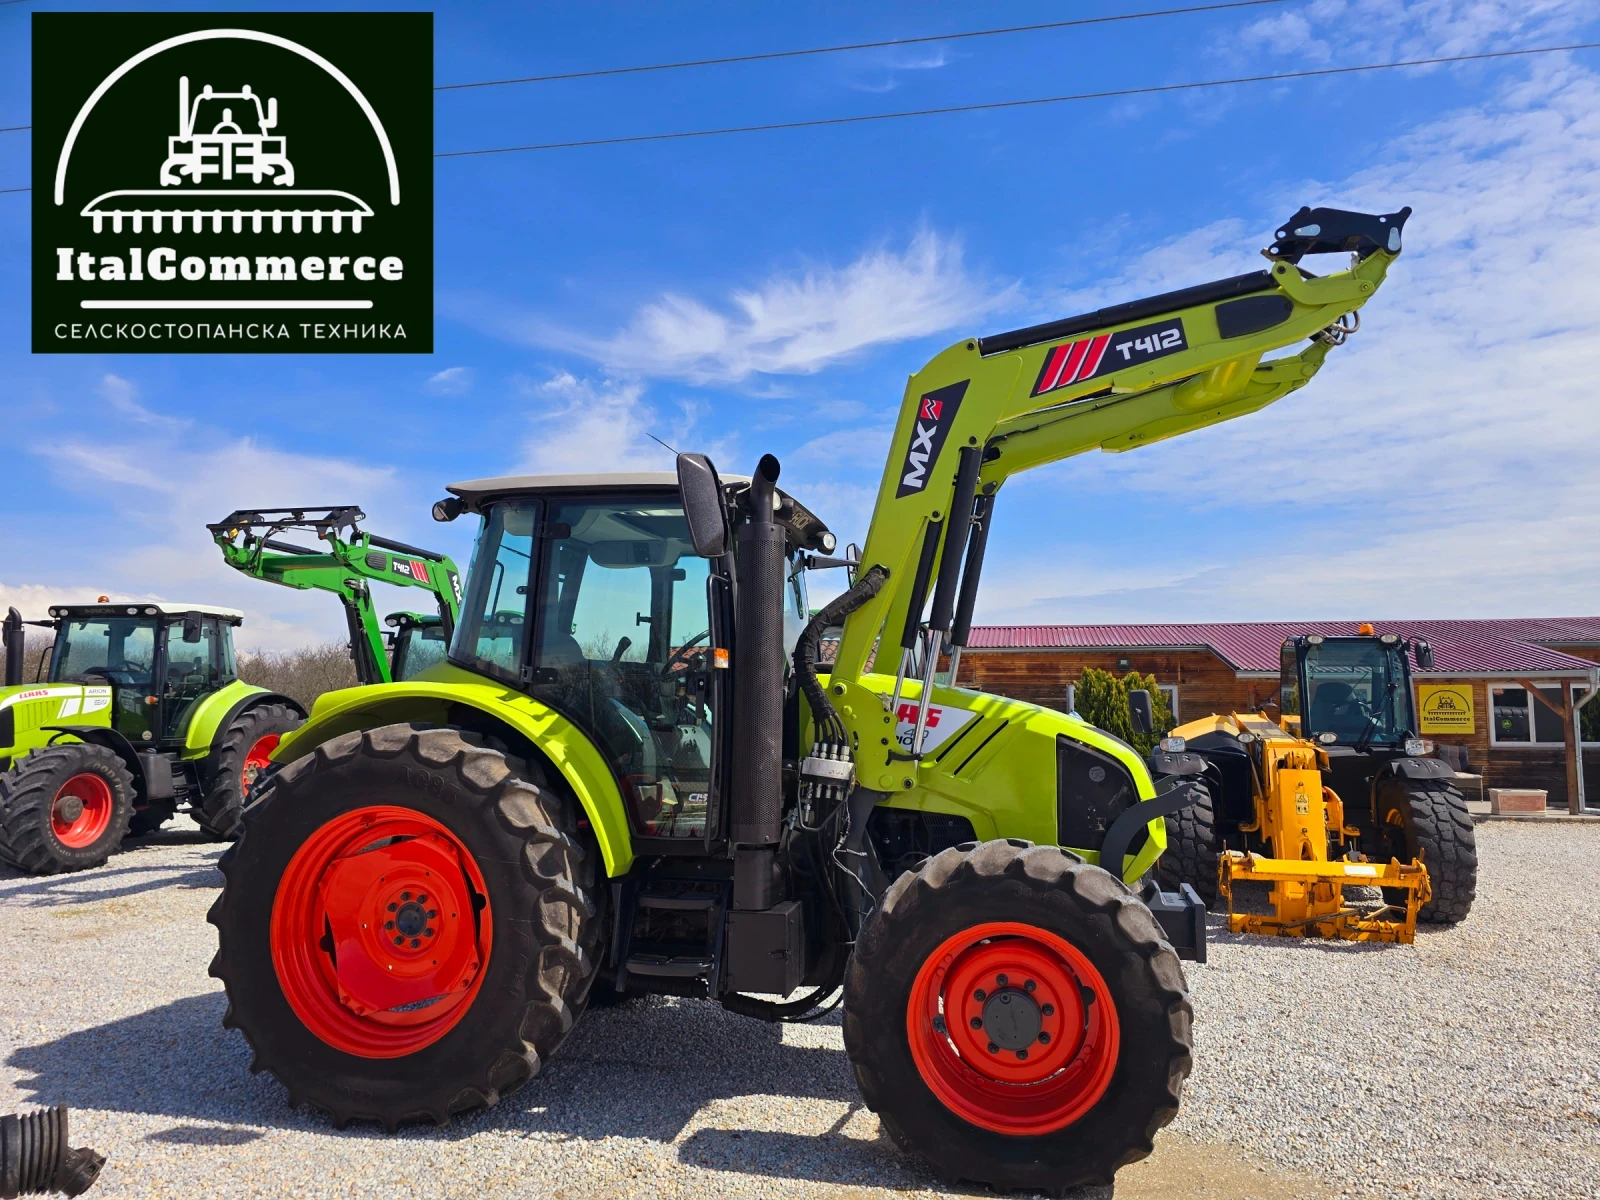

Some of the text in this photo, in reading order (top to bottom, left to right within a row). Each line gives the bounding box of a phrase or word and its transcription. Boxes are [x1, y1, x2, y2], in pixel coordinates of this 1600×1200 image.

[1115, 328, 1183, 360] T412
[902, 420, 938, 488] MX
[392, 561, 410, 575] T412
[451, 574, 463, 605] MX
[19, 689, 49, 699] CLAAS
